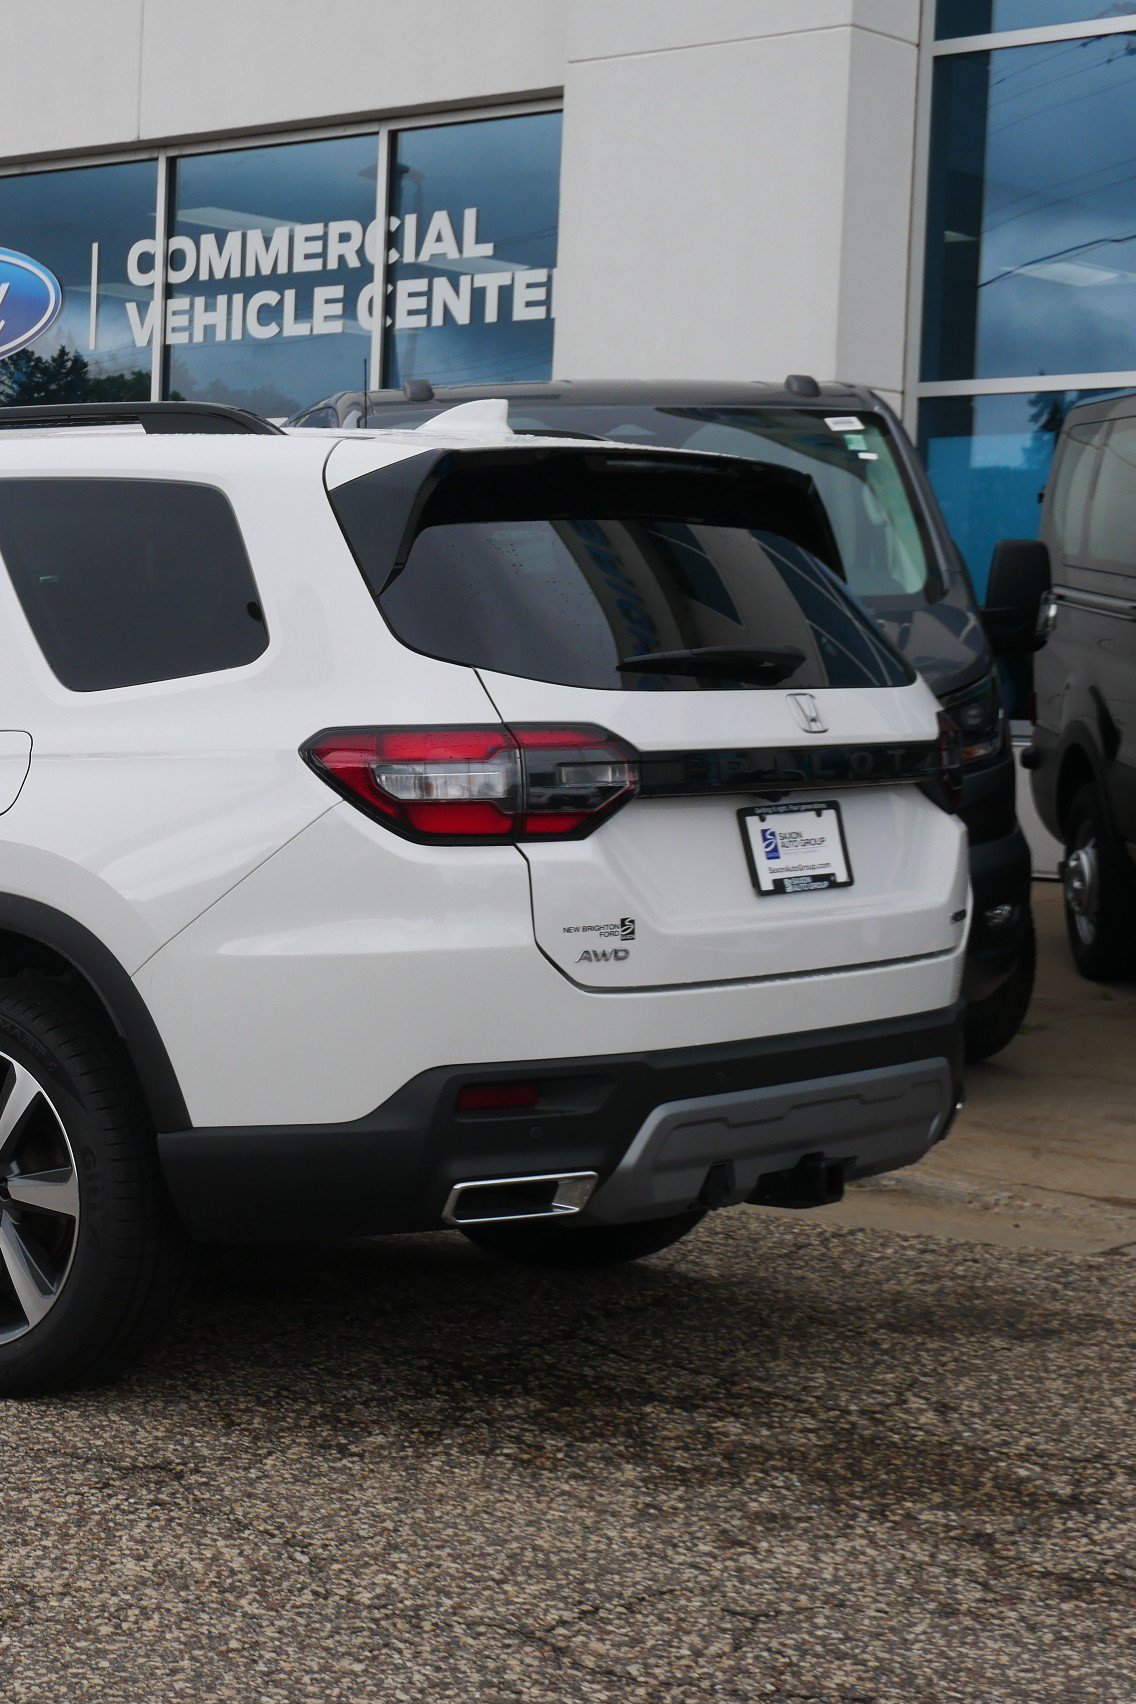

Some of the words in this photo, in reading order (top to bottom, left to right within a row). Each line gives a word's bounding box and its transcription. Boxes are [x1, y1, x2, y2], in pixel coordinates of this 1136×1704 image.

[127, 207, 495, 287] COMMERCIAL
[126, 285, 344, 347] VEHICLE
[356, 268, 559, 331] CENTE
[563, 926, 581, 934] NEW
[582, 923, 620, 933] BRIGHTON
[599, 930, 620, 938] FORD
[575, 948, 630, 963] AWD
